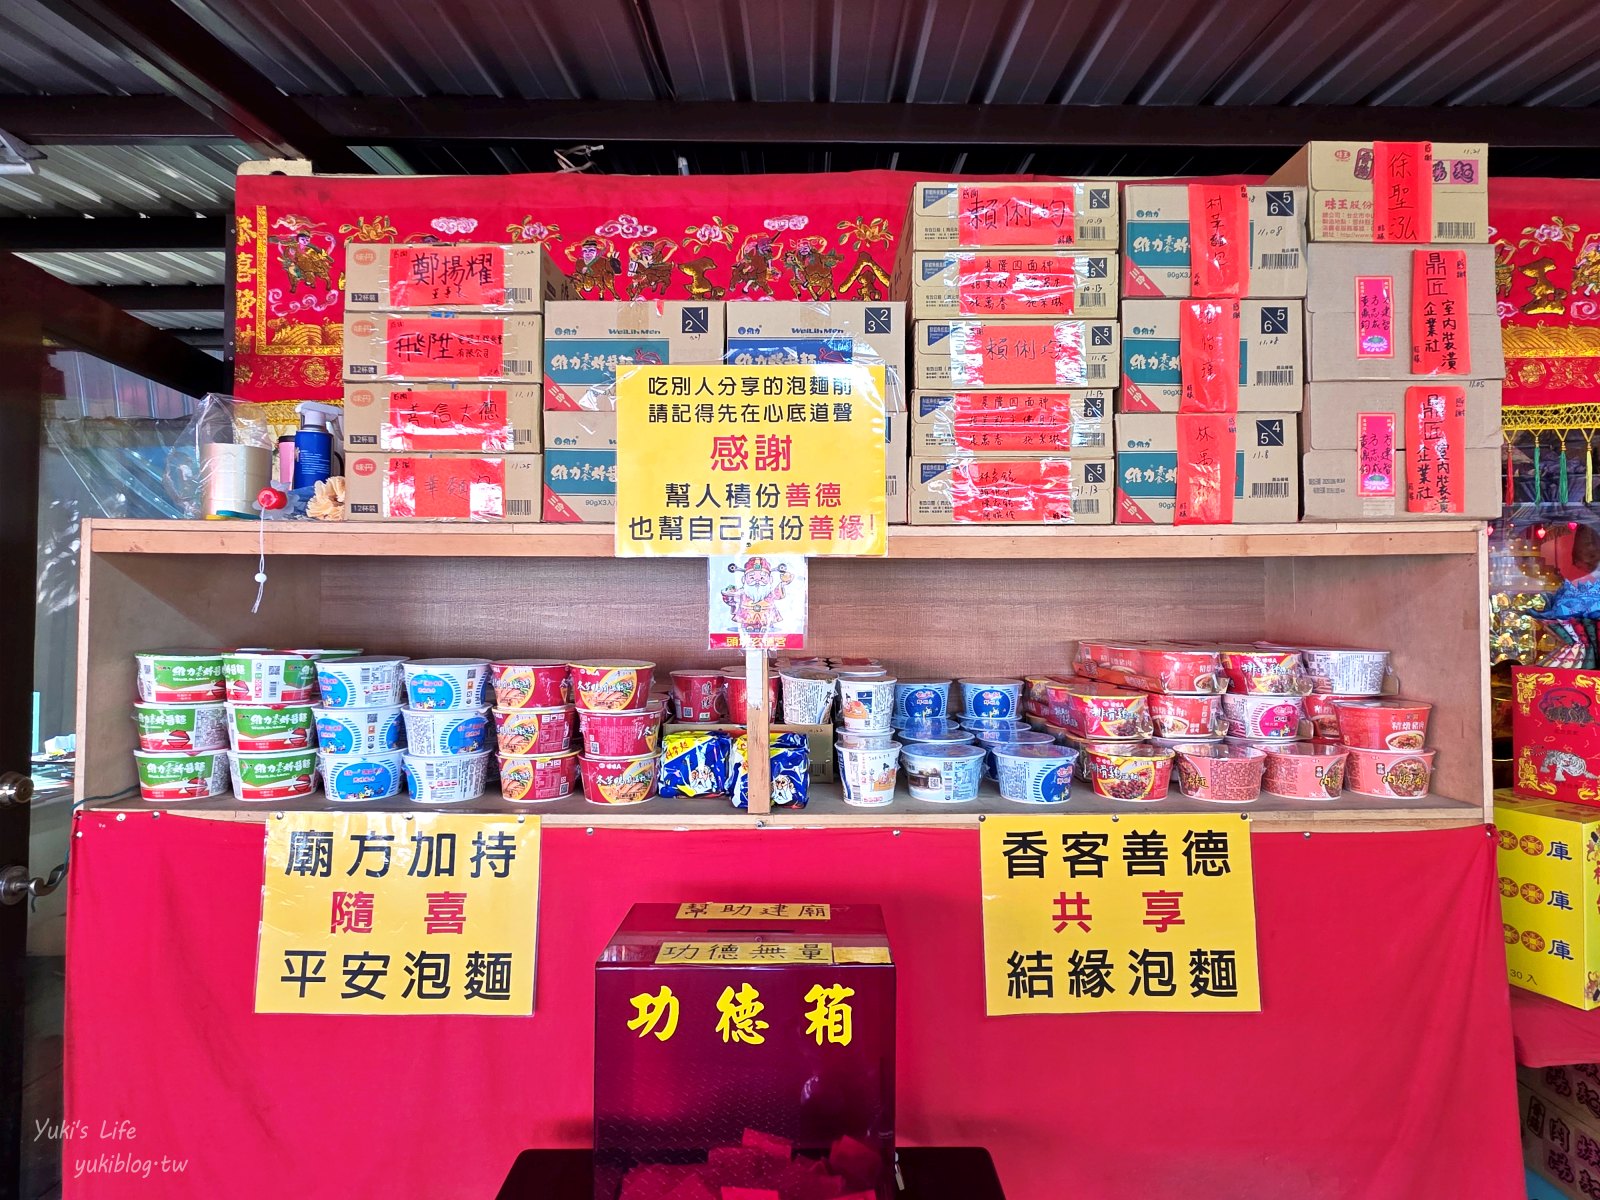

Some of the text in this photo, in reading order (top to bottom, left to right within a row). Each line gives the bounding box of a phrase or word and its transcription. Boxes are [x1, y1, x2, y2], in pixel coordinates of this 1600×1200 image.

[1101, 191, 1107, 200] 4
[1283, 192, 1291, 203] 5
[1092, 199, 1098, 207] 5
[1270, 202, 1279, 214] 6
[411, 253, 493, 286] 鄭揚耀
[1099, 260, 1105, 269] 4
[1090, 269, 1096, 277] 5
[1426, 252, 1448, 296] 鼎匠
[699, 310, 705, 320] 1
[880, 310, 888, 320] 2
[1277, 310, 1285, 321] 5
[685, 320, 694, 332] 2
[868, 321, 876, 332] 3
[1264, 321, 1273, 332] 6
[1424, 301, 1440, 352] 企業社
[1103, 328, 1109, 337] 5
[1441, 299, 1457, 370] 室內裝潢
[1095, 336, 1101, 344] 6
[648, 376, 852, 397] 吃別人分享的泡麵前
[1096, 400, 1102, 408] 5
[648, 403, 852, 423] 請記得先在心底道聲
[1087, 408, 1093, 416] 6
[1272, 422, 1280, 433] 4
[1260, 433, 1268, 444] 5
[710, 434, 792, 472] 感謝
[1097, 465, 1103, 474] 5
[1417, 445, 1433, 500] 企業社
[1088, 474, 1094, 482] 6
[665, 483, 842, 508] 幫人積份善德
[285, 830, 516, 878] 廟方加持
[1002, 830, 1231, 879] 香客善德
[1546, 841, 1573, 861] 庫
[1547, 890, 1573, 910] 庫
[684, 903, 826, 918] 幫助建廟
[662, 943, 831, 961] 功德無量
[1548, 939, 1574, 960] 庫
[281, 950, 513, 1000] 平安泡麵
[1007, 949, 1238, 999] 結緣泡麵
[627, 982, 855, 1046] 功德箱
